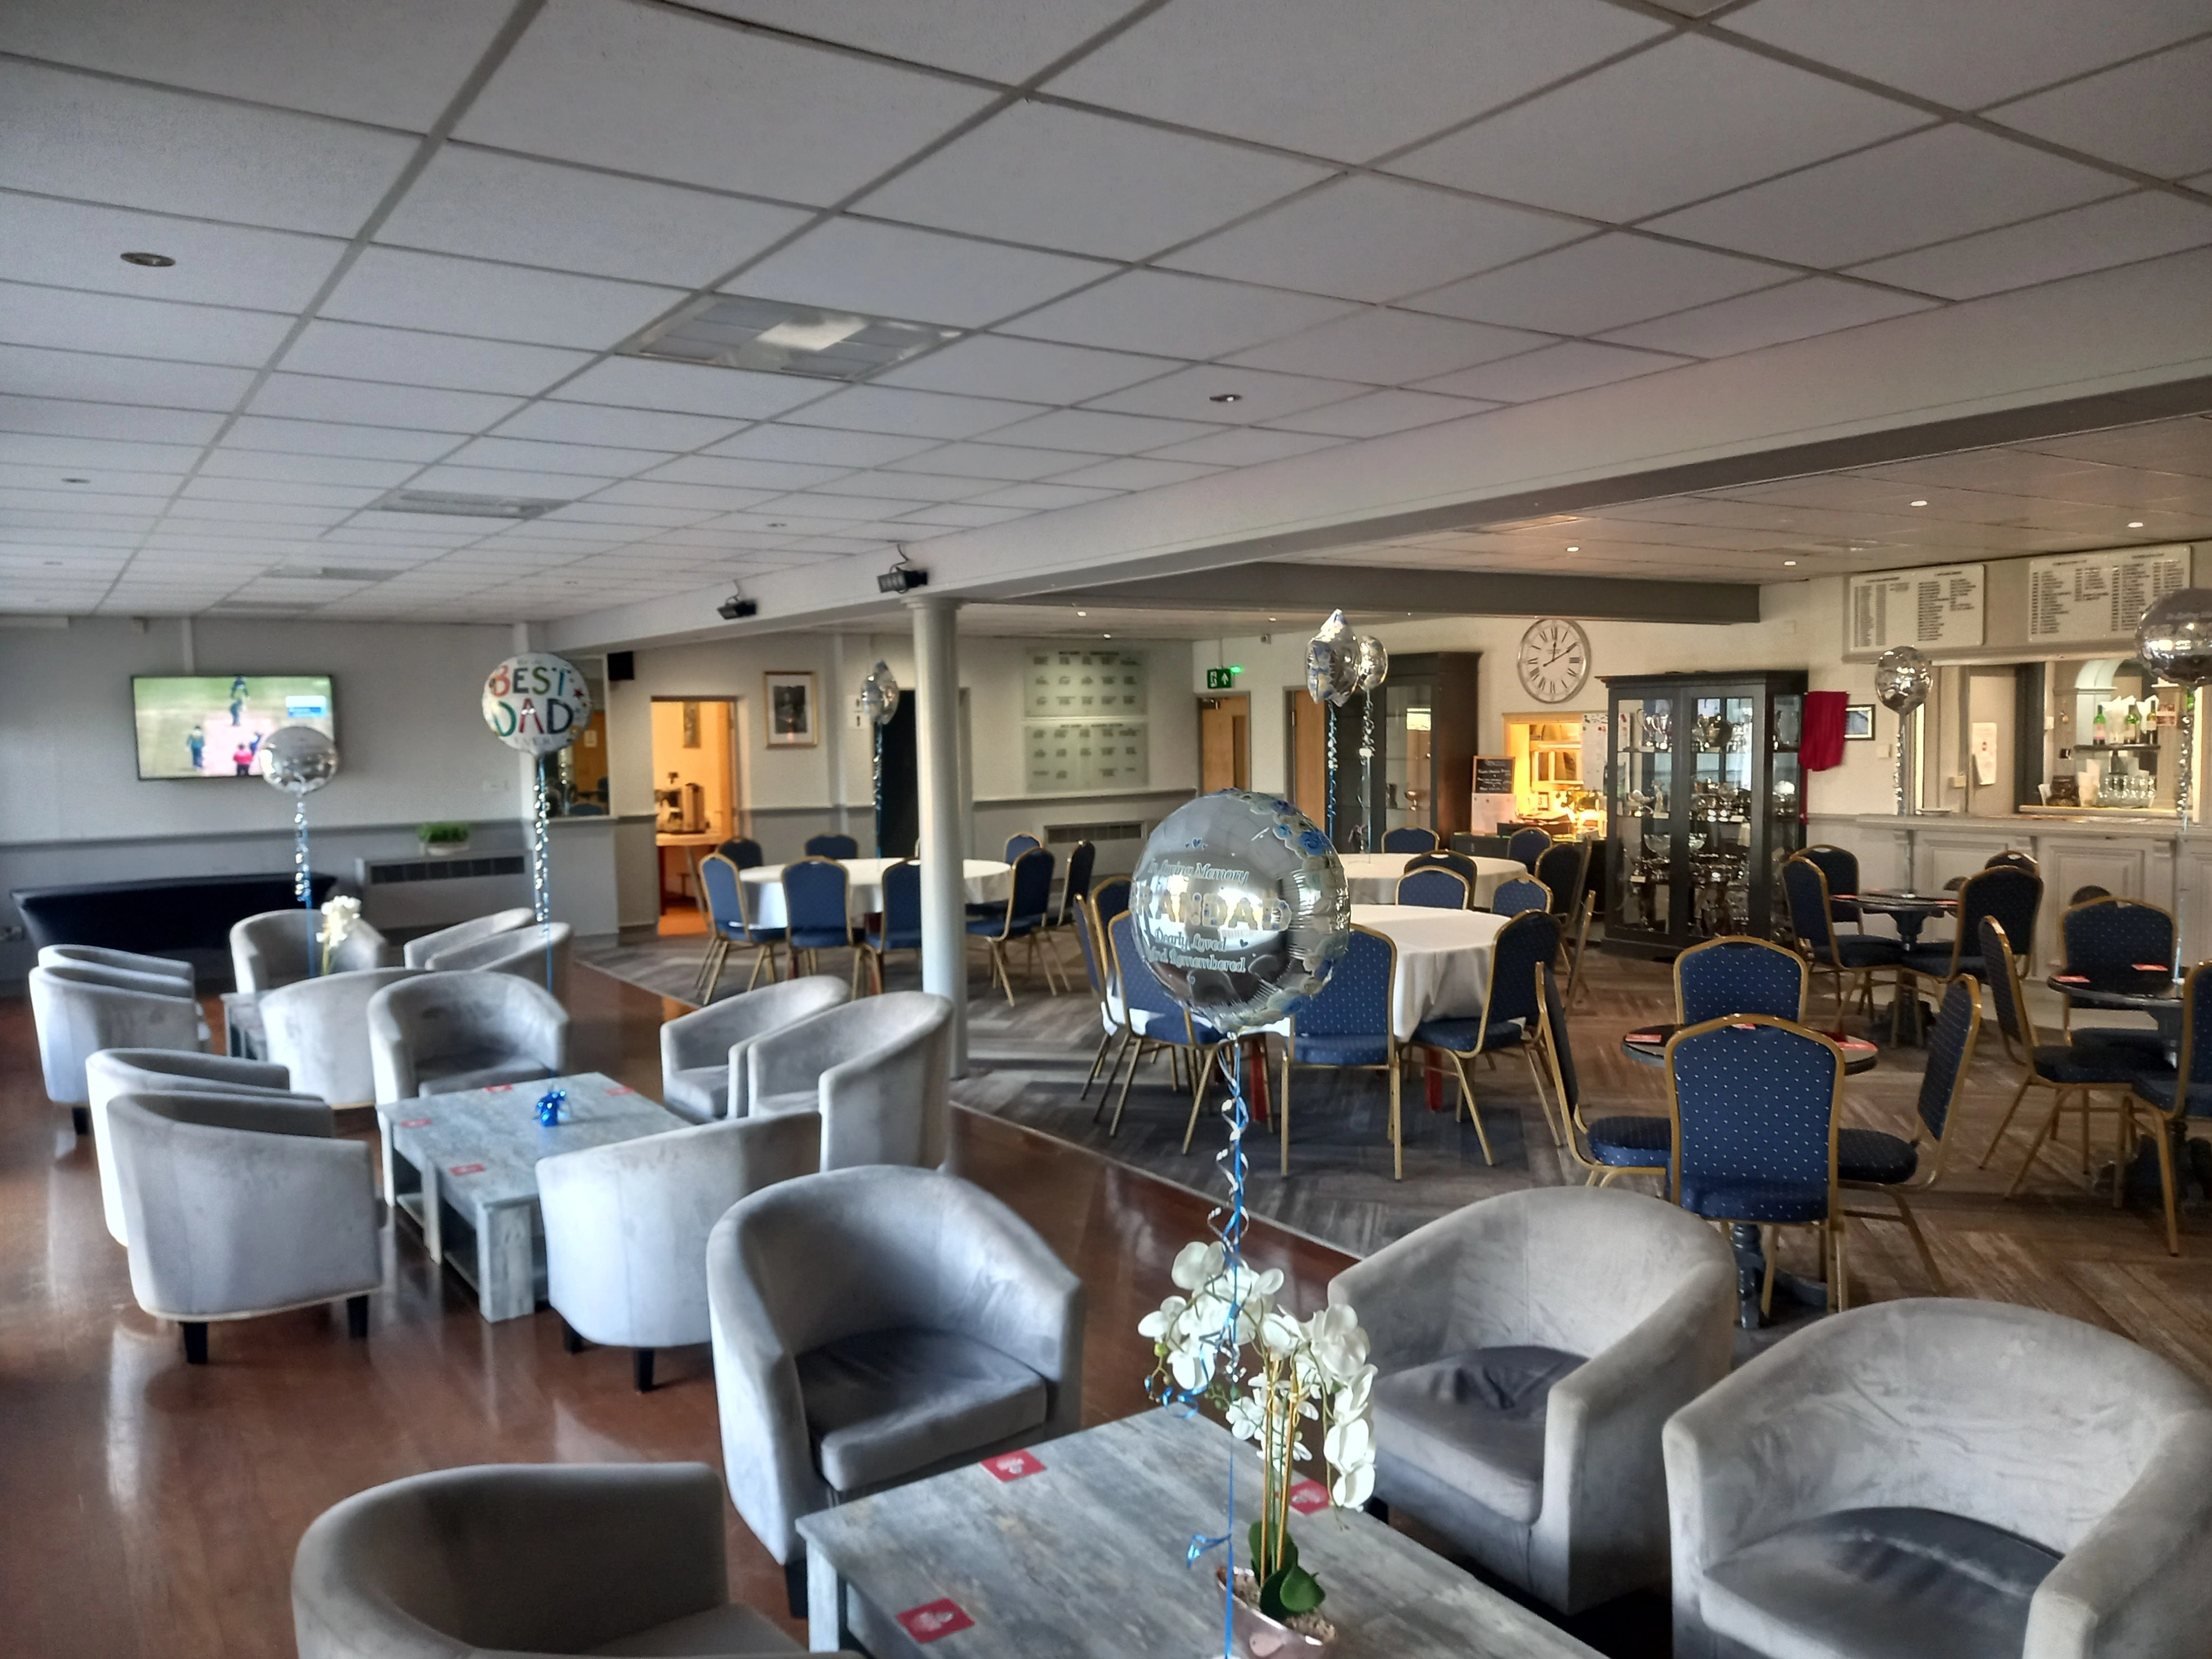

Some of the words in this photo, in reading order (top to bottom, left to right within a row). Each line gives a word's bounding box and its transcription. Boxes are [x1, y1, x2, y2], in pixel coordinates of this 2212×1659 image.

[490, 664, 571, 697] BEST
[493, 698, 574, 737] DAD
[1195, 862, 1249, 885] Memory
[1154, 926, 1191, 952] Dearly
[1190, 933, 1226, 953] Loved
